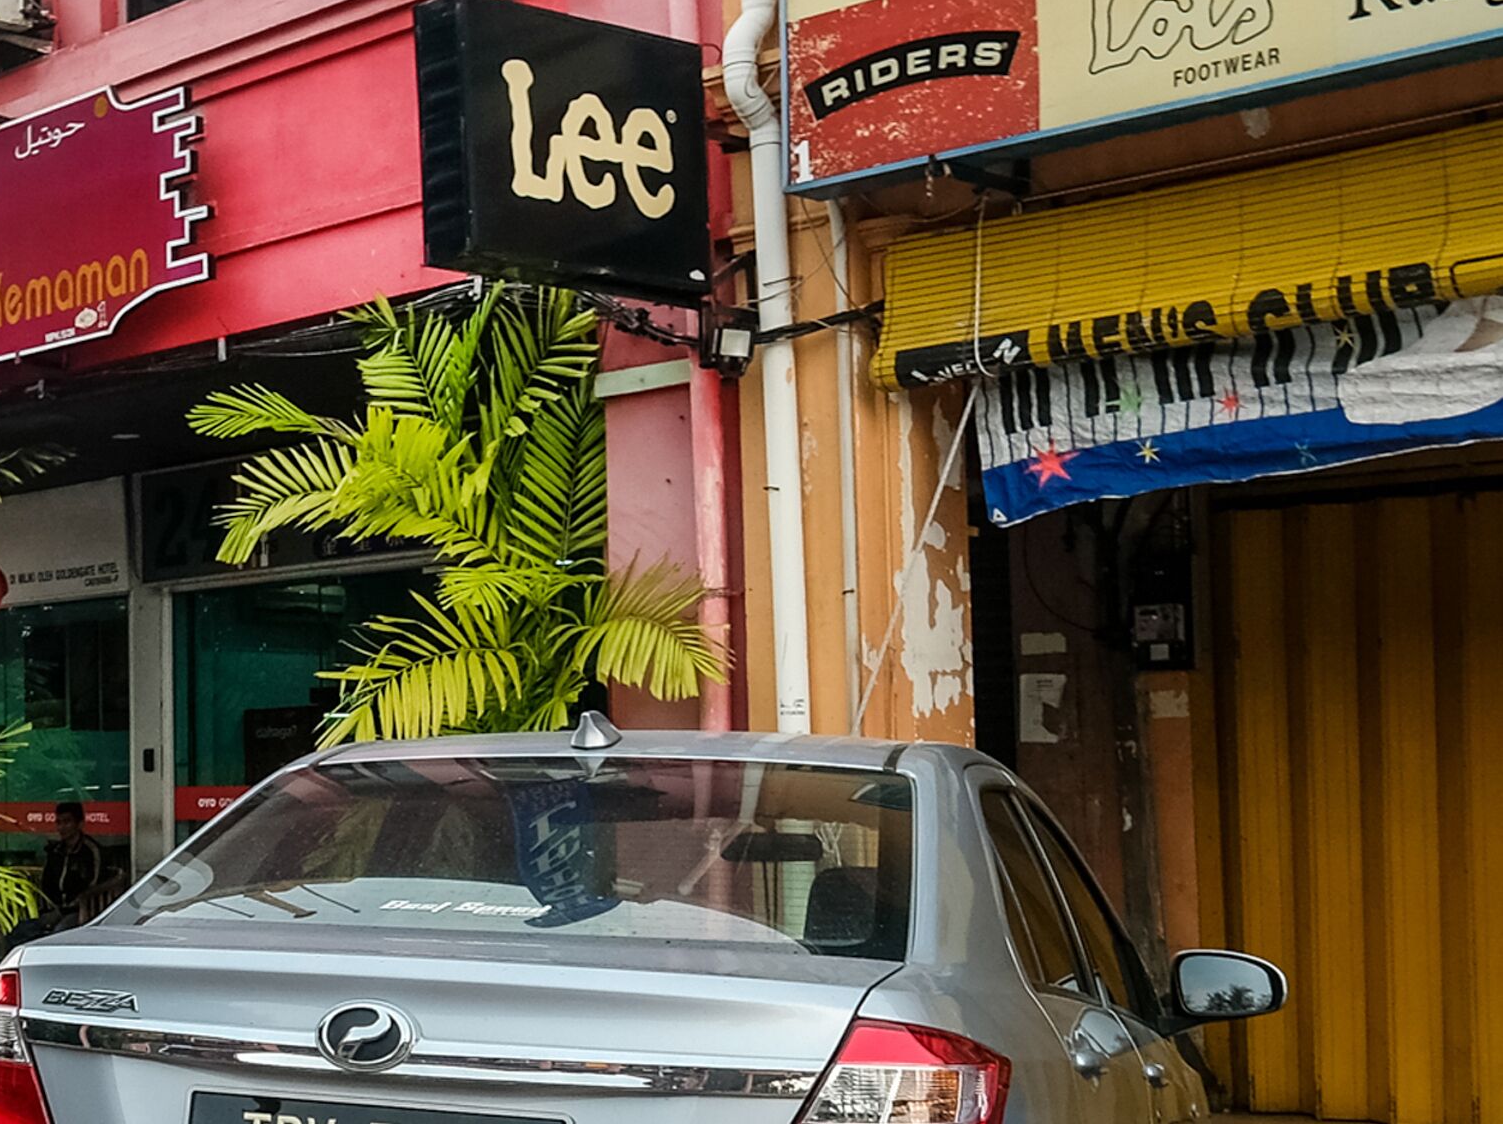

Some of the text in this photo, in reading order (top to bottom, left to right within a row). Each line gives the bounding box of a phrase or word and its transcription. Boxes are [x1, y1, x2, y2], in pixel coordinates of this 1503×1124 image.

[820, 41, 1003, 108] RIDERS
[1172, 47, 1282, 88] FOOTWEAR
[14, 119, 86, 159] حوتيل
[501, 59, 675, 219] Lee
[41, 987, 140, 1013] BEZZA
